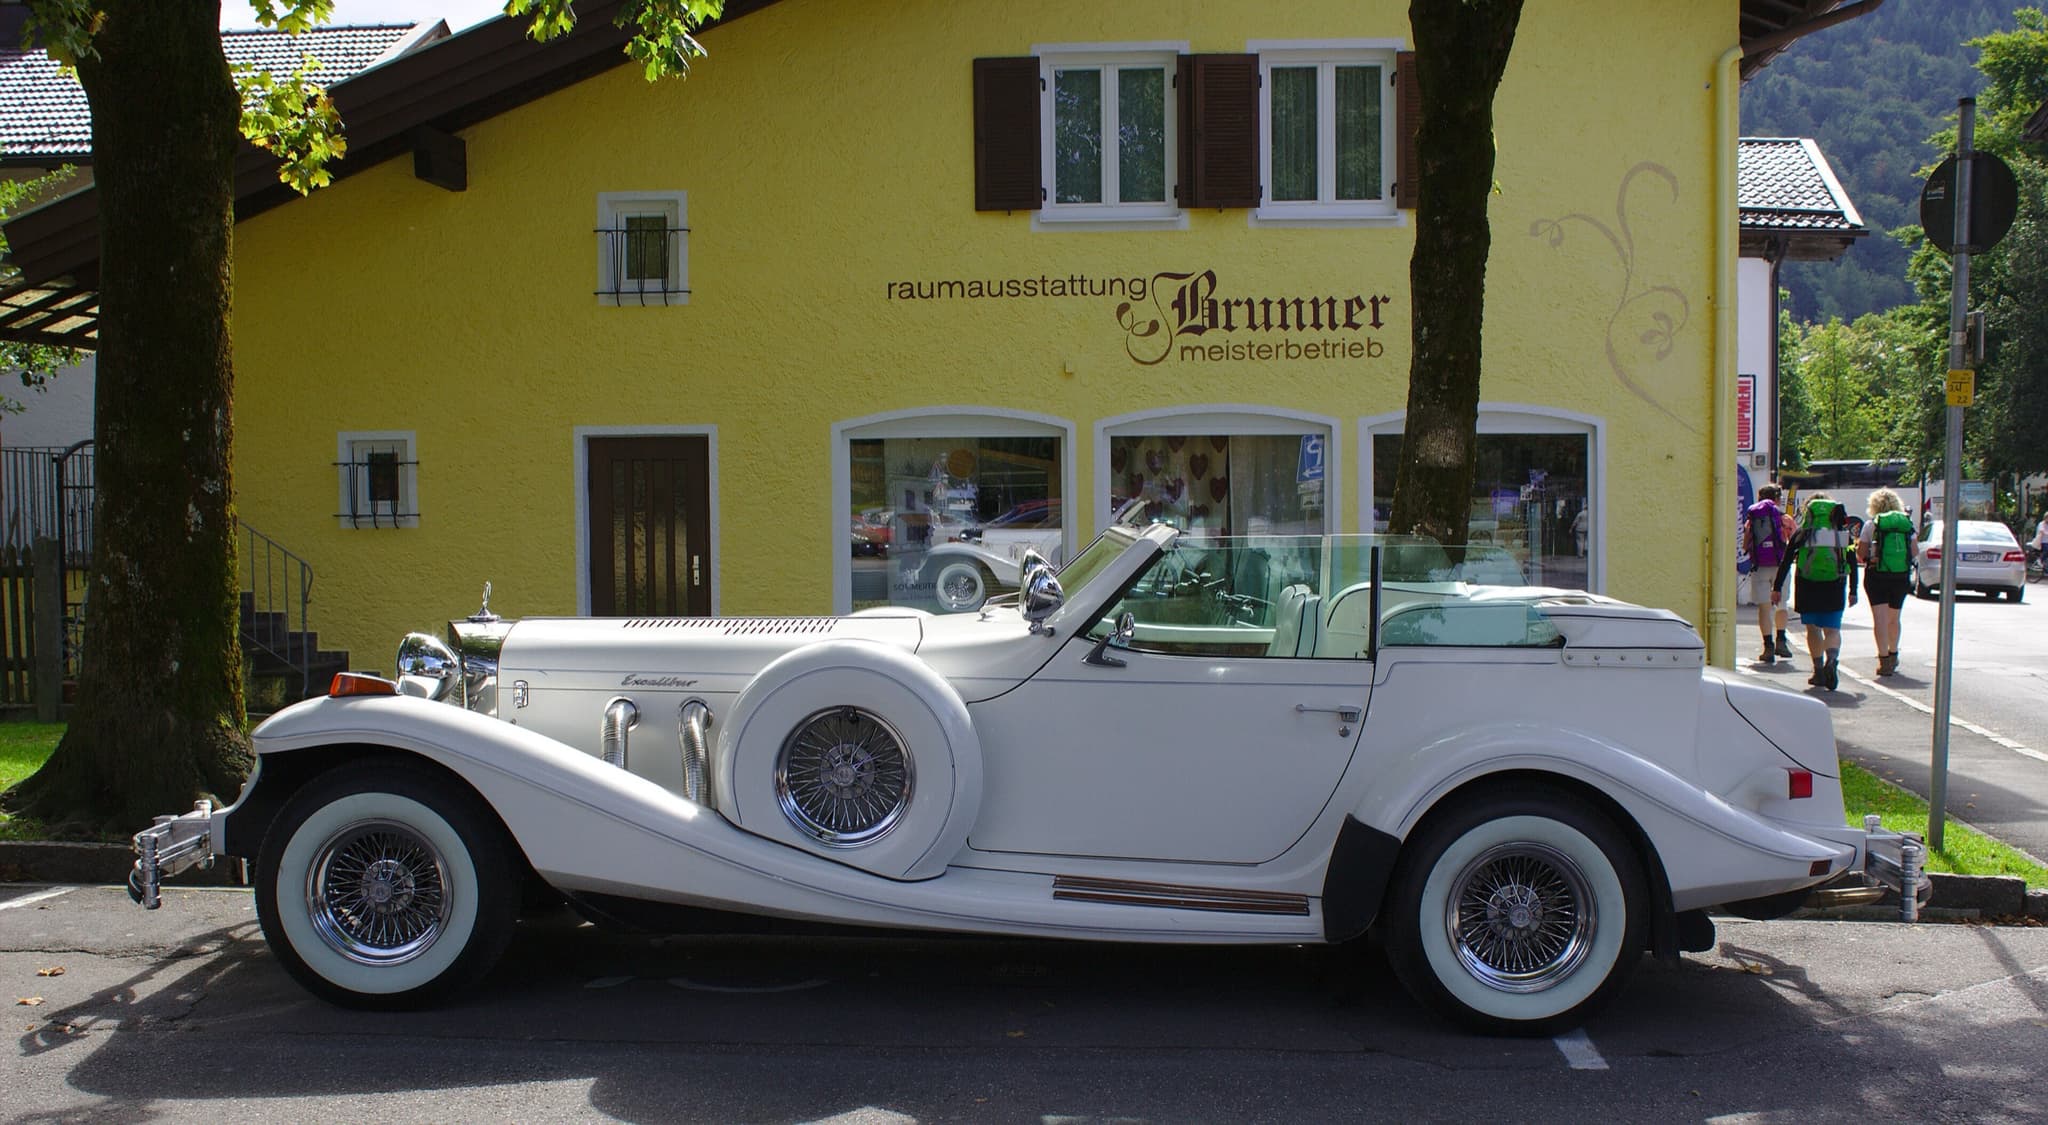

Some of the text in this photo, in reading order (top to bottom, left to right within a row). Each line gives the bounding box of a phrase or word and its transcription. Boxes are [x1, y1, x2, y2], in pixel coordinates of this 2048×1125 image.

[887, 274, 1147, 301] raumausstattung
[1152, 269, 1391, 337] Brunner
[1180, 337, 1384, 362] meisterbetrieb
[621, 673, 698, 687] Excalibur
